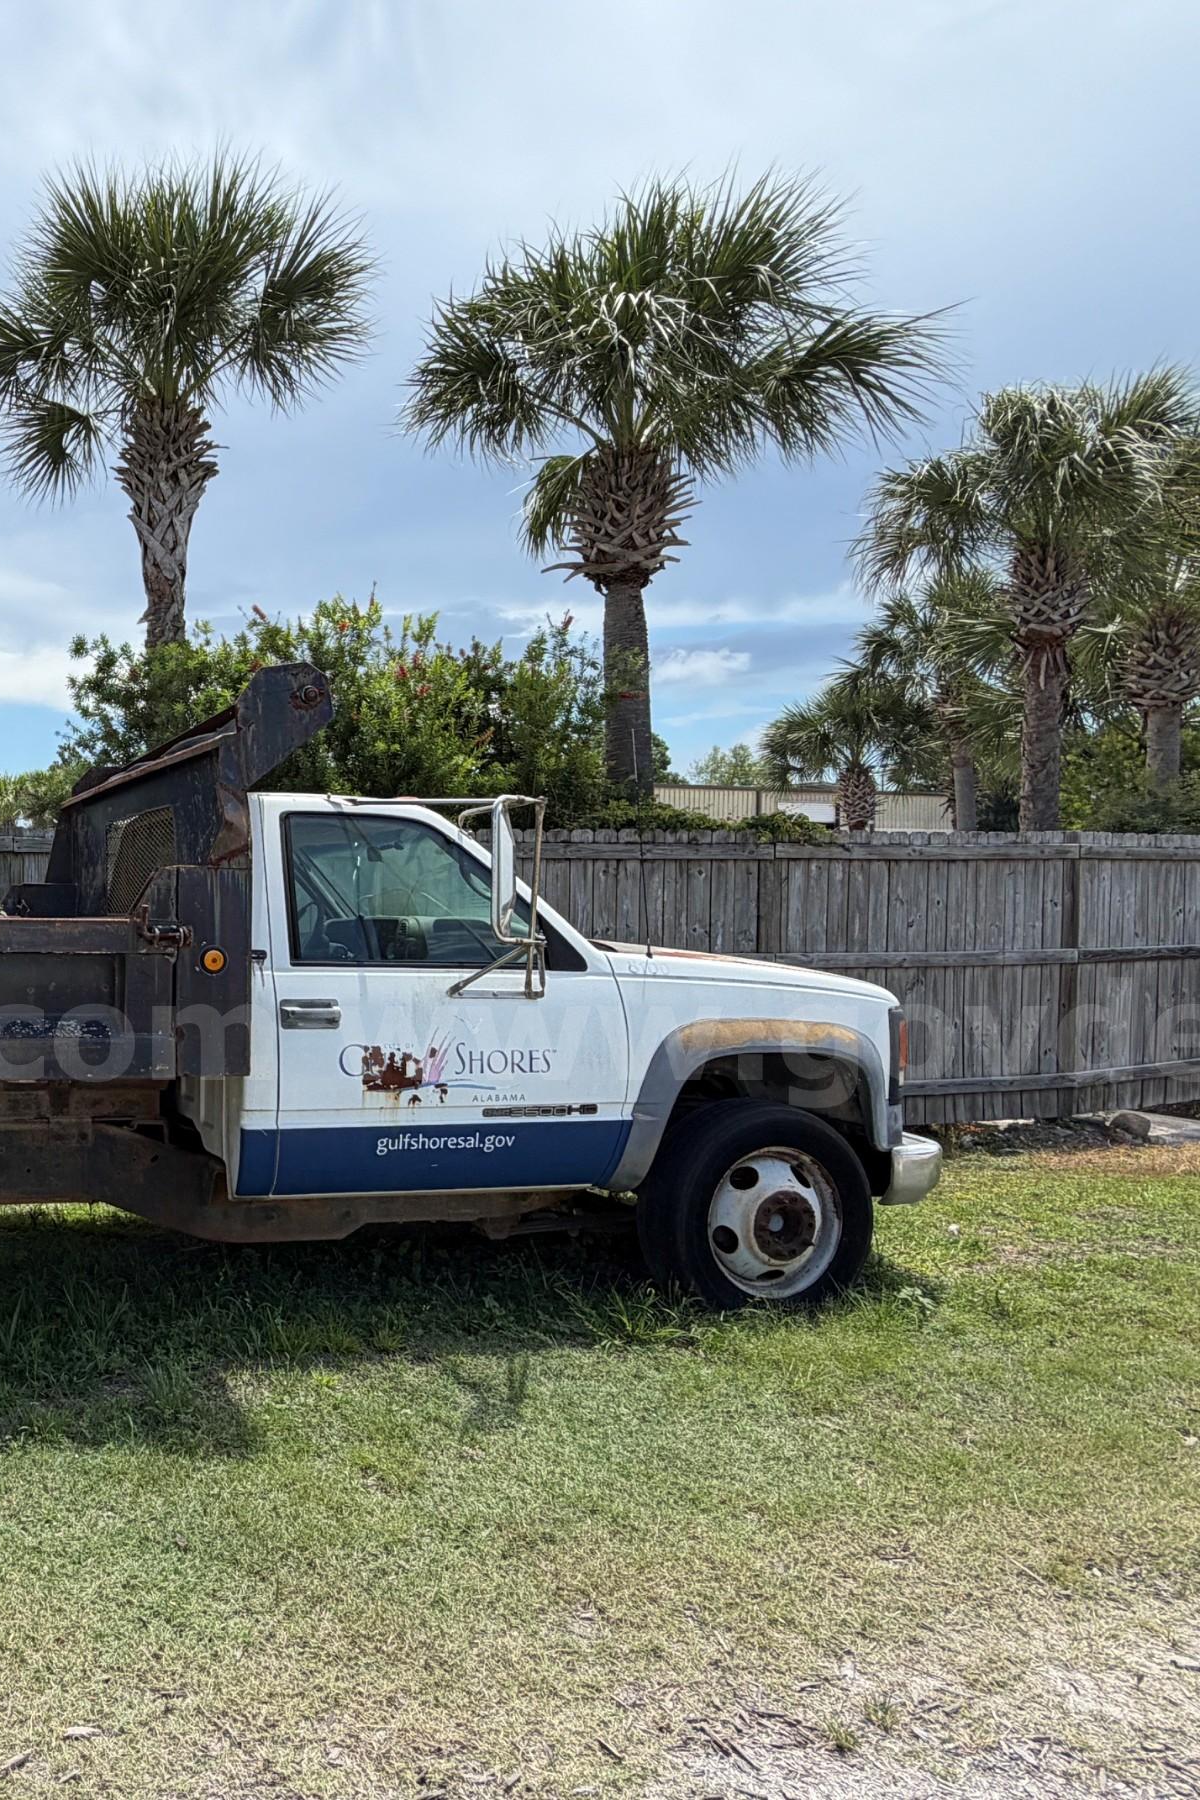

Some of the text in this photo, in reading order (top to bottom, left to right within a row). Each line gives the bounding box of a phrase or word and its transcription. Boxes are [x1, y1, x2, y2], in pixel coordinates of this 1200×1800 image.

[455, 1042, 552, 1075] SHORES
[472, 1094, 526, 1102] ALABAMA
[376, 1132, 516, 1156] gulfshoresal.gov
